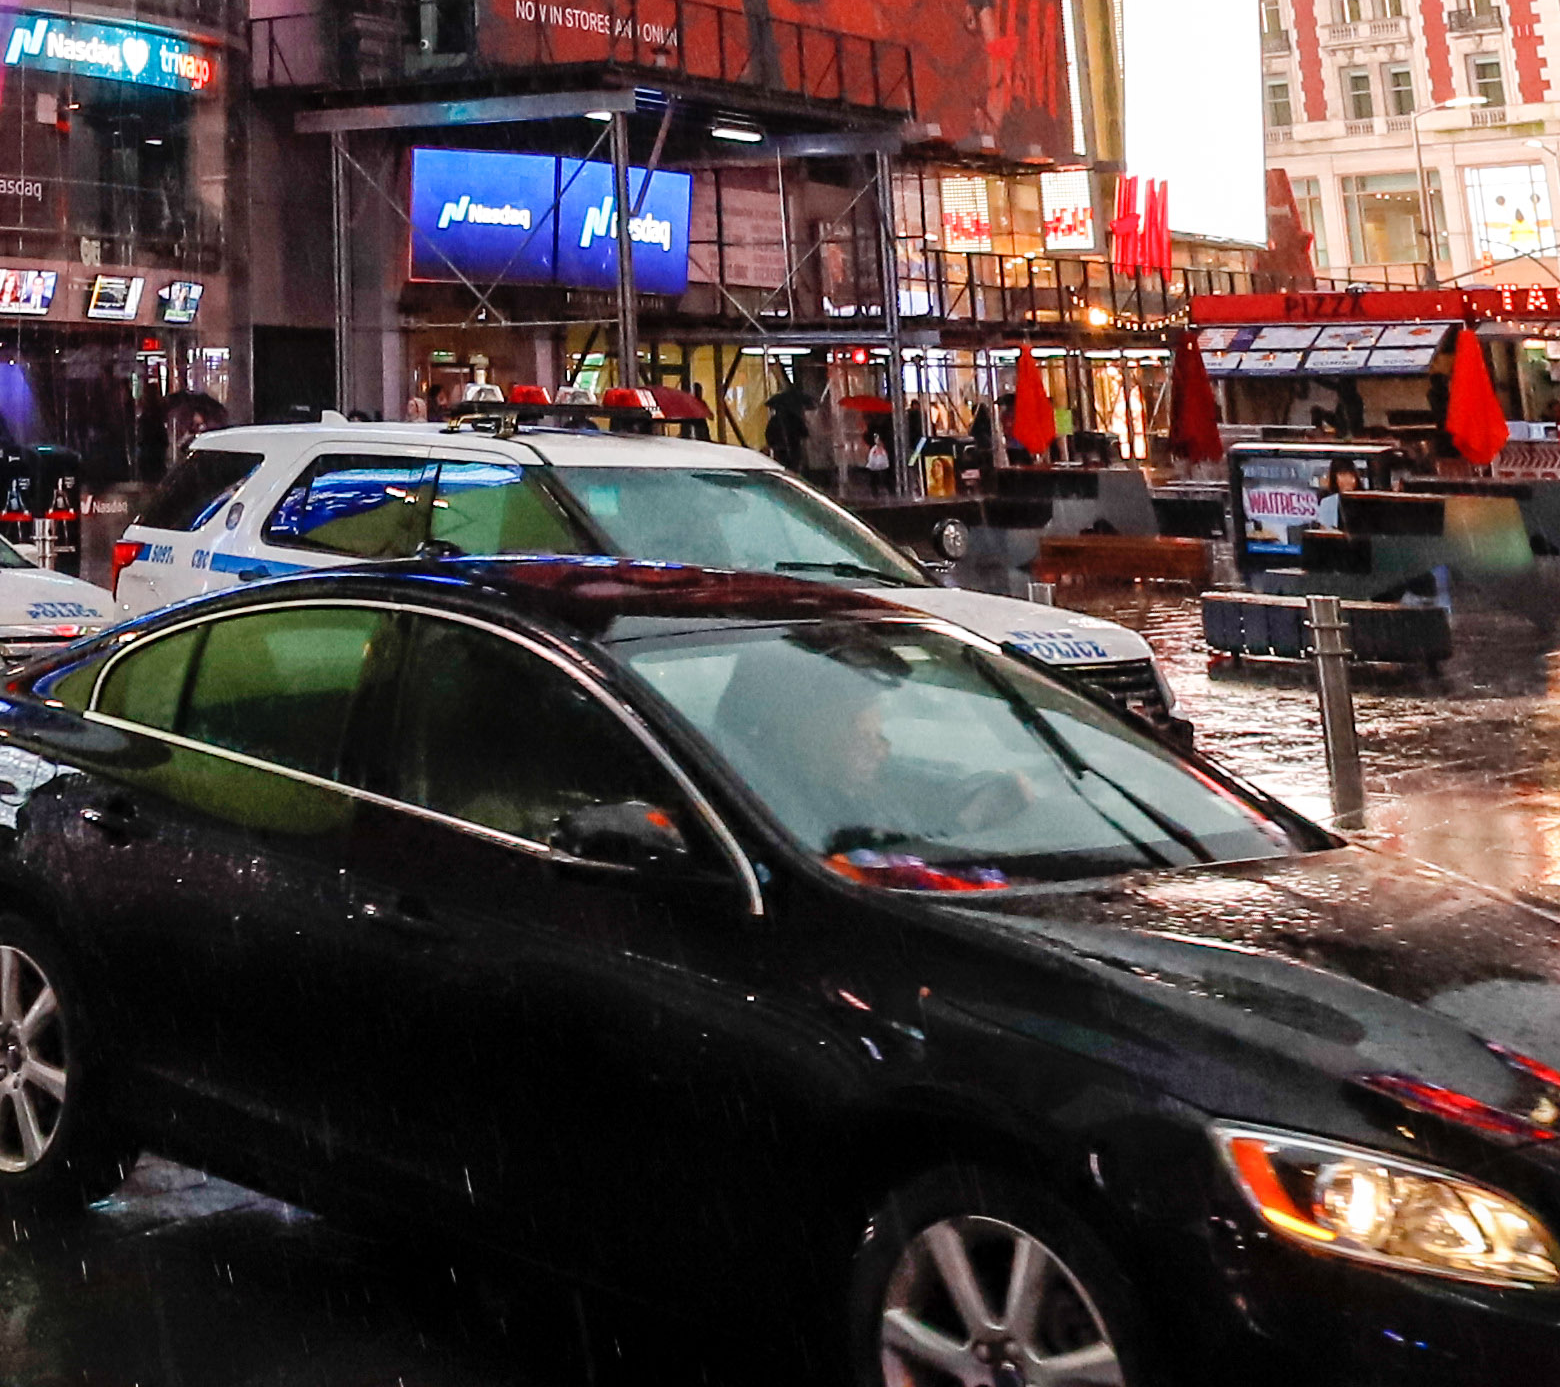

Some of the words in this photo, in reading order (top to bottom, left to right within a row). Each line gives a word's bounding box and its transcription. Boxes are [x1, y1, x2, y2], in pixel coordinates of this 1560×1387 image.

[565, 7, 611, 35] STORES
[47, 29, 123, 72] Nasdaq
[159, 44, 210, 88] trivago
[467, 203, 532, 231] Nasdaq
[92, 500, 128, 514] Nasdaq
[1247, 489, 1317, 517] WAITRESS
